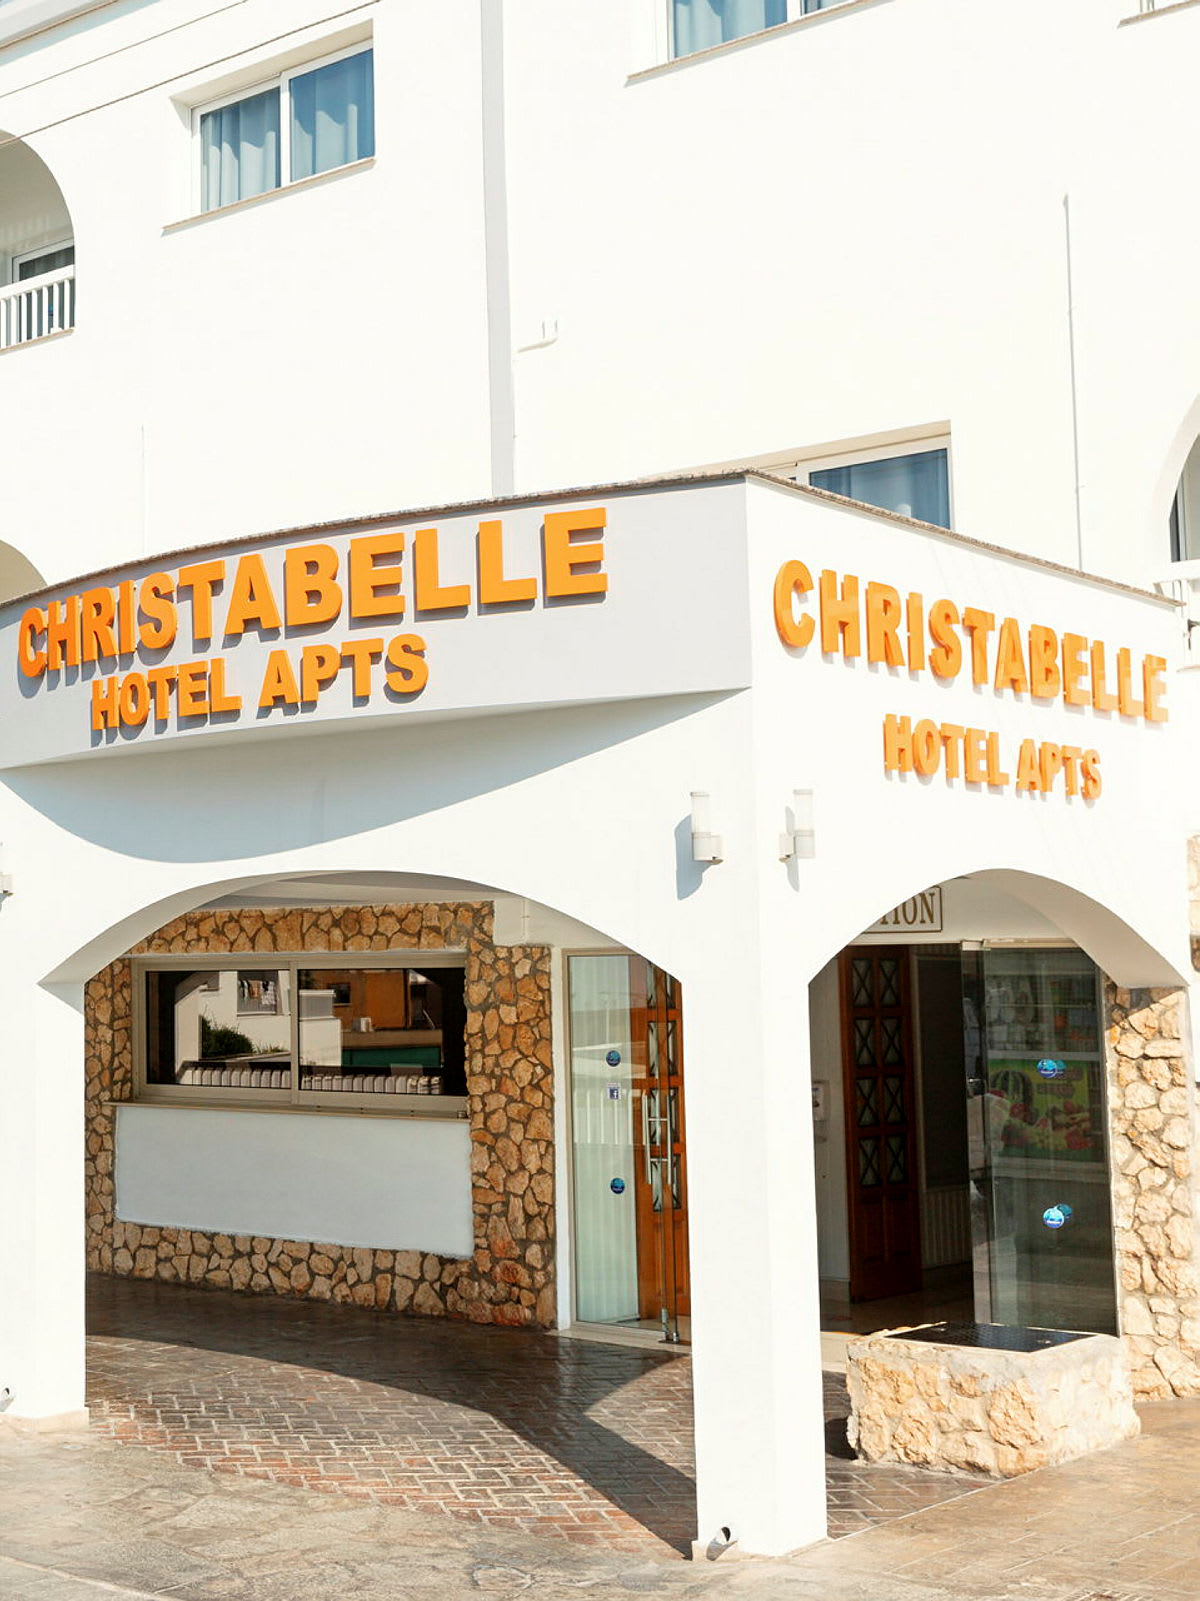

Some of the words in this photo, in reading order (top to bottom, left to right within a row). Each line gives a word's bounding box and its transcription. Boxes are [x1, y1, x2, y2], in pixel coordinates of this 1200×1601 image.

[17, 507, 609, 679] CHRISTABELLE
[773, 559, 1169, 722] CHRISTABELLE
[91, 657, 243, 731] HOTEL
[258, 633, 429, 709] APTS
[882, 713, 1010, 787] HOTEL
[1016, 738, 1102, 801] APTS
[880, 892, 936, 925] ION
